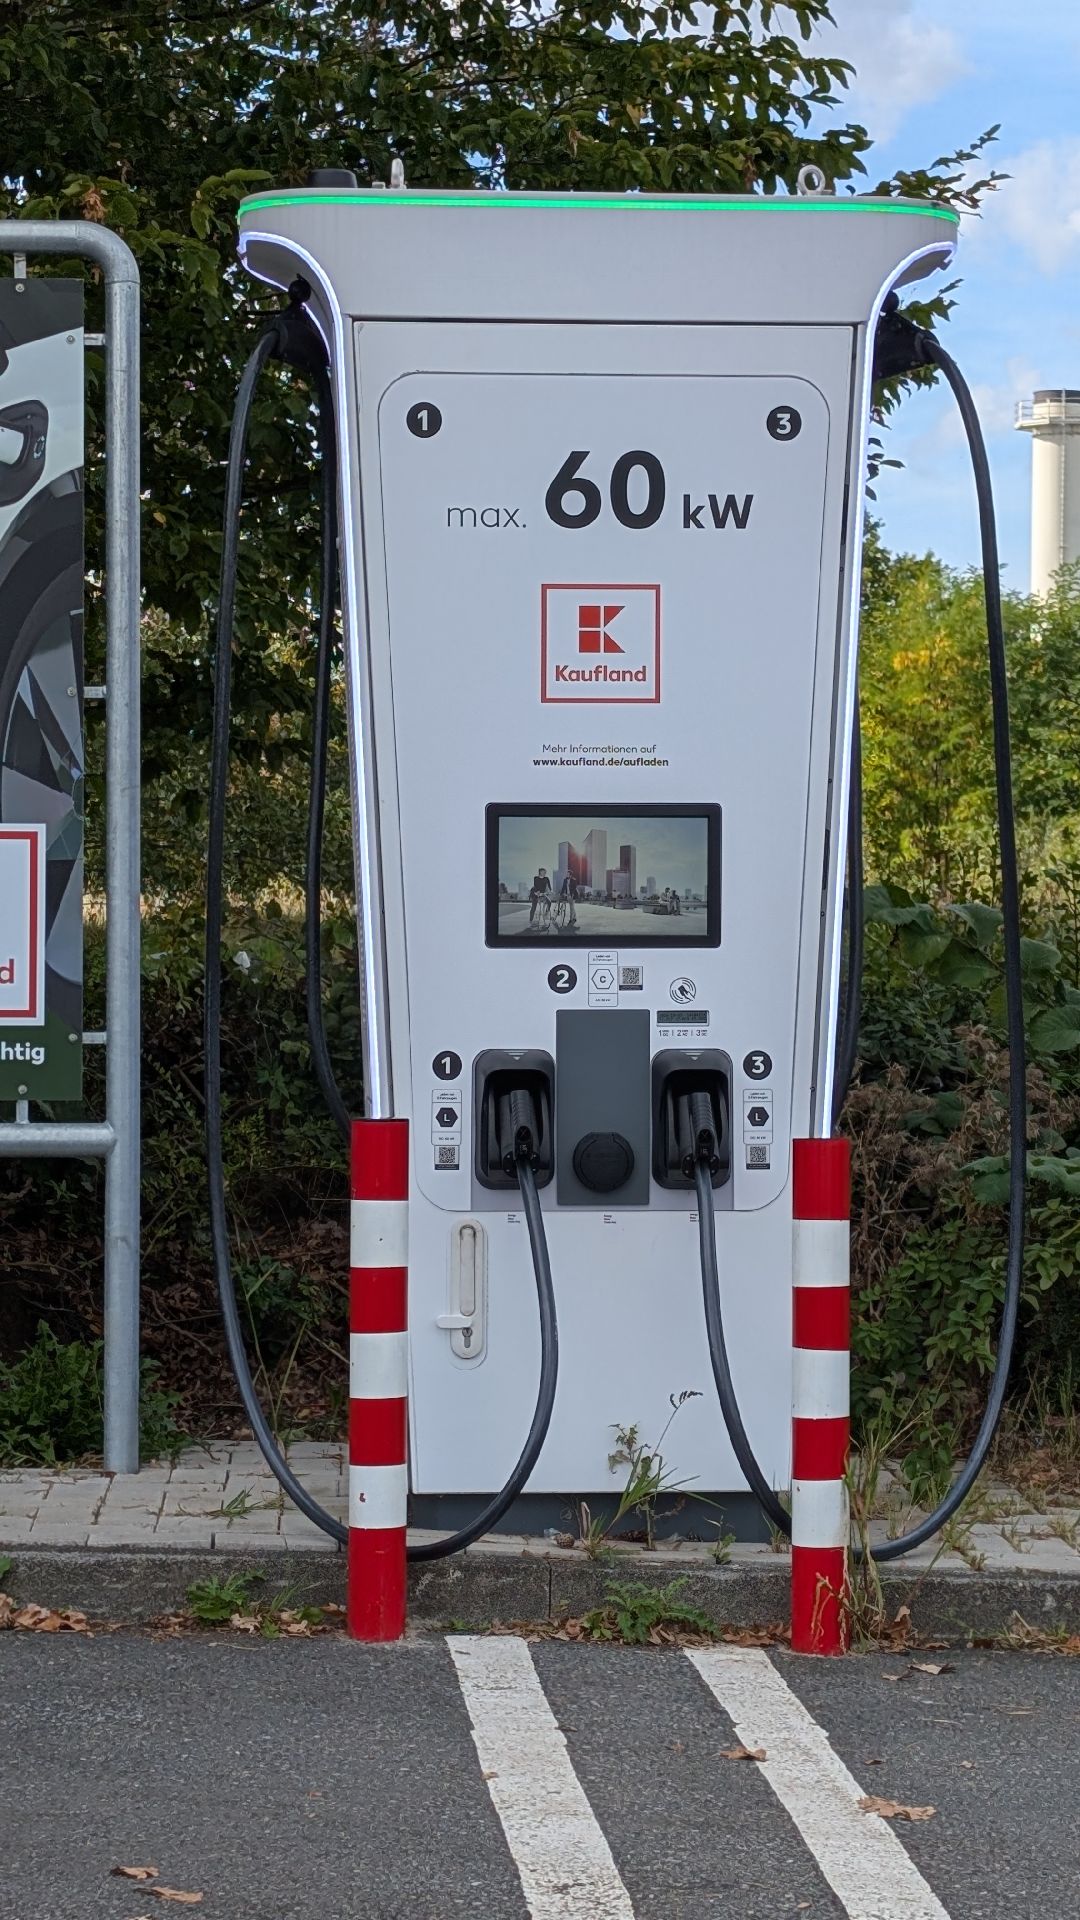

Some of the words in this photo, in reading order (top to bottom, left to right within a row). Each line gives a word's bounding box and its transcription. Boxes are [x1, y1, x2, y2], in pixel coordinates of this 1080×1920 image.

[418, 410, 428, 430] 1
[776, 413, 791, 434] 3
[447, 507, 527, 529] max.
[545, 450, 666, 530] 60
[683, 494, 754, 529] kW
[555, 664, 647, 682] Kaufland
[542, 744, 567, 753] Mehr
[570, 744, 638, 754] Informationen
[640, 744, 656, 754] auf
[533, 757, 669, 767] www.kaufland.de/aufladen
[557, 969, 570, 988] 2
[600, 975, 607, 984] C
[1, 1041, 45, 1065] htig
[441, 1056, 451, 1074] 1
[751, 1056, 765, 1074] 3
[444, 1113, 451, 1122] L
[755, 1112, 762, 1121] L
